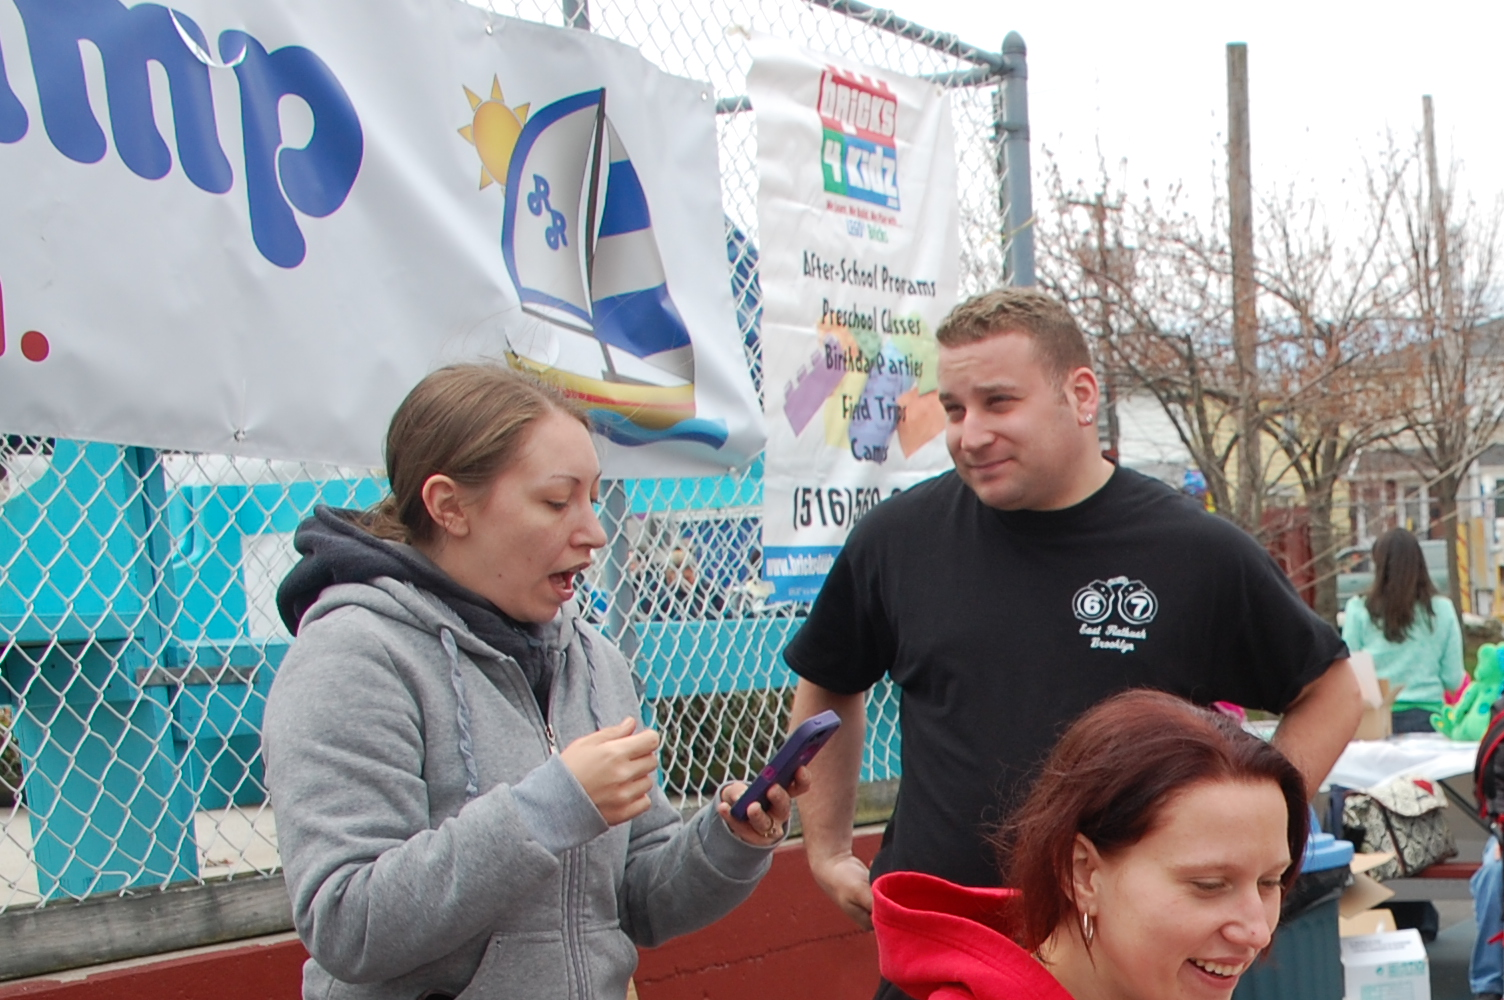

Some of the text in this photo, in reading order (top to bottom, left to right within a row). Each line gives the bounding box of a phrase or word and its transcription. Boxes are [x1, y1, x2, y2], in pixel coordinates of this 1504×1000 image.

[0, 0, 364, 269] mp
[823, 138, 842, 182] 4
[803, 250, 877, 290] After-School
[822, 298, 877, 333] Preschool
[876, 351, 924, 378] Parties
[1083, 595, 1147, 617] 6 7
